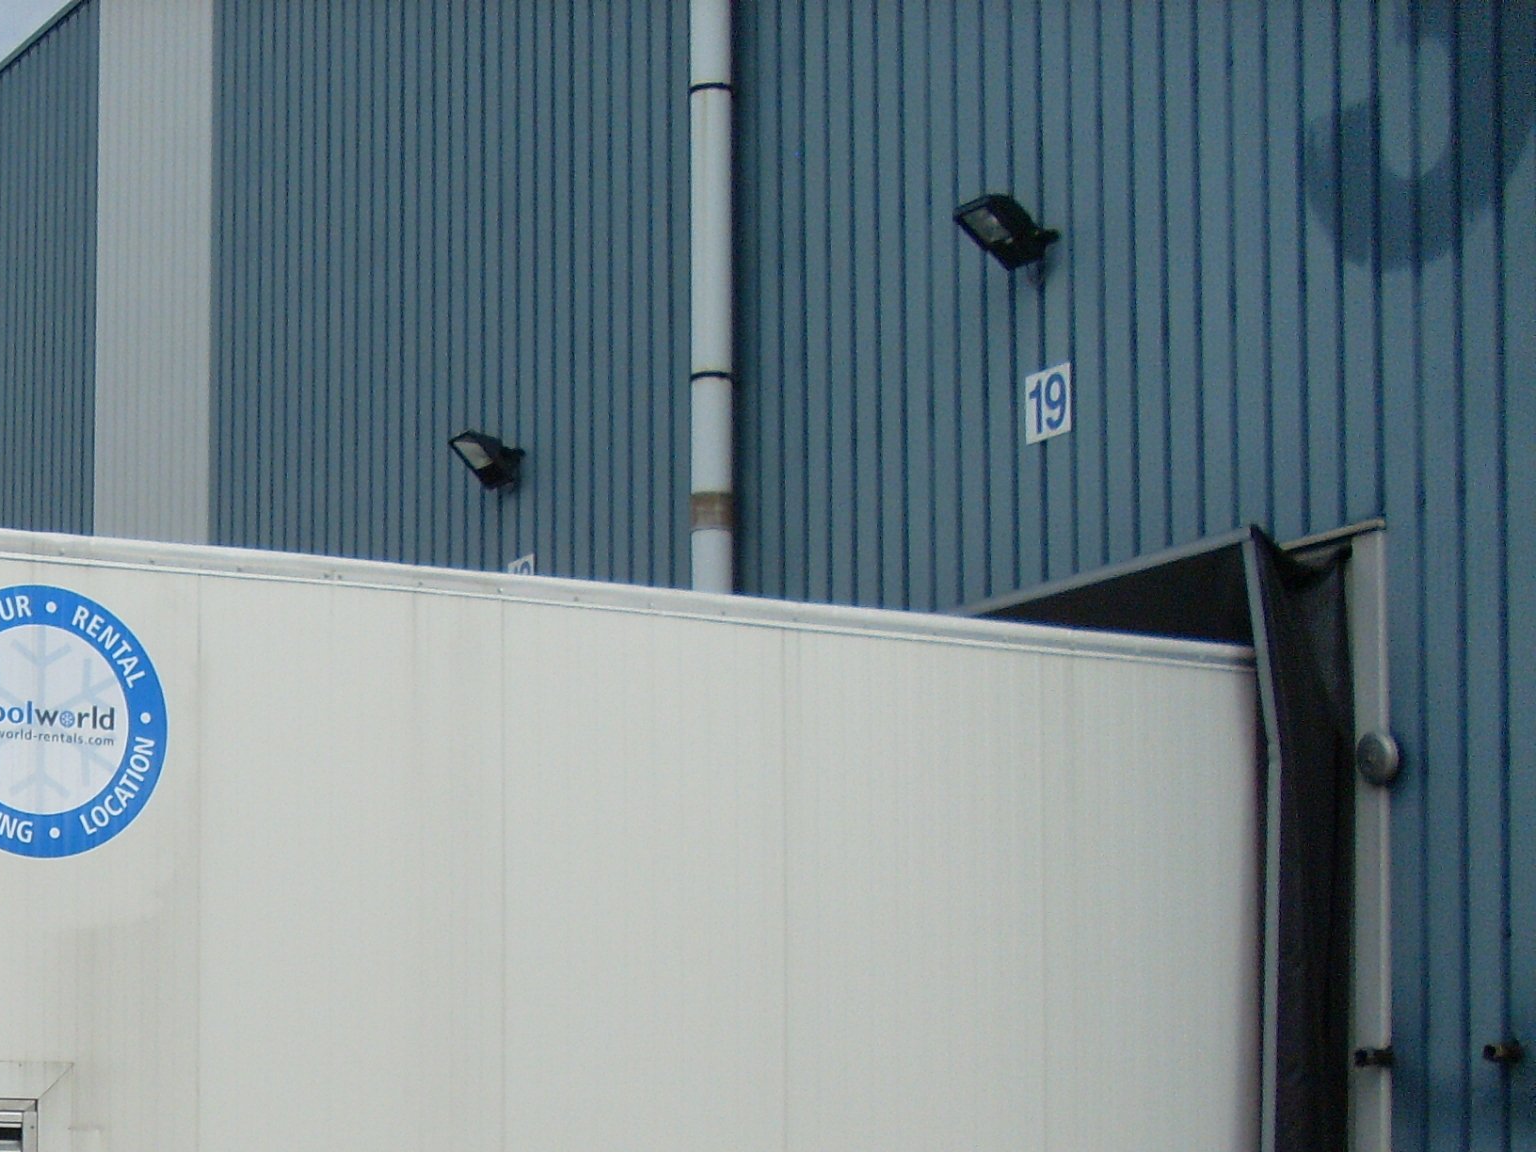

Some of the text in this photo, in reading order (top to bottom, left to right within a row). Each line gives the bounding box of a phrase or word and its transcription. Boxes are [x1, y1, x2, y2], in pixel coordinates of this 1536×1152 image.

[1029, 372, 1066, 434] 19
[72, 605, 146, 689] RENTAL
[79, 736, 155, 836] LOCATION
